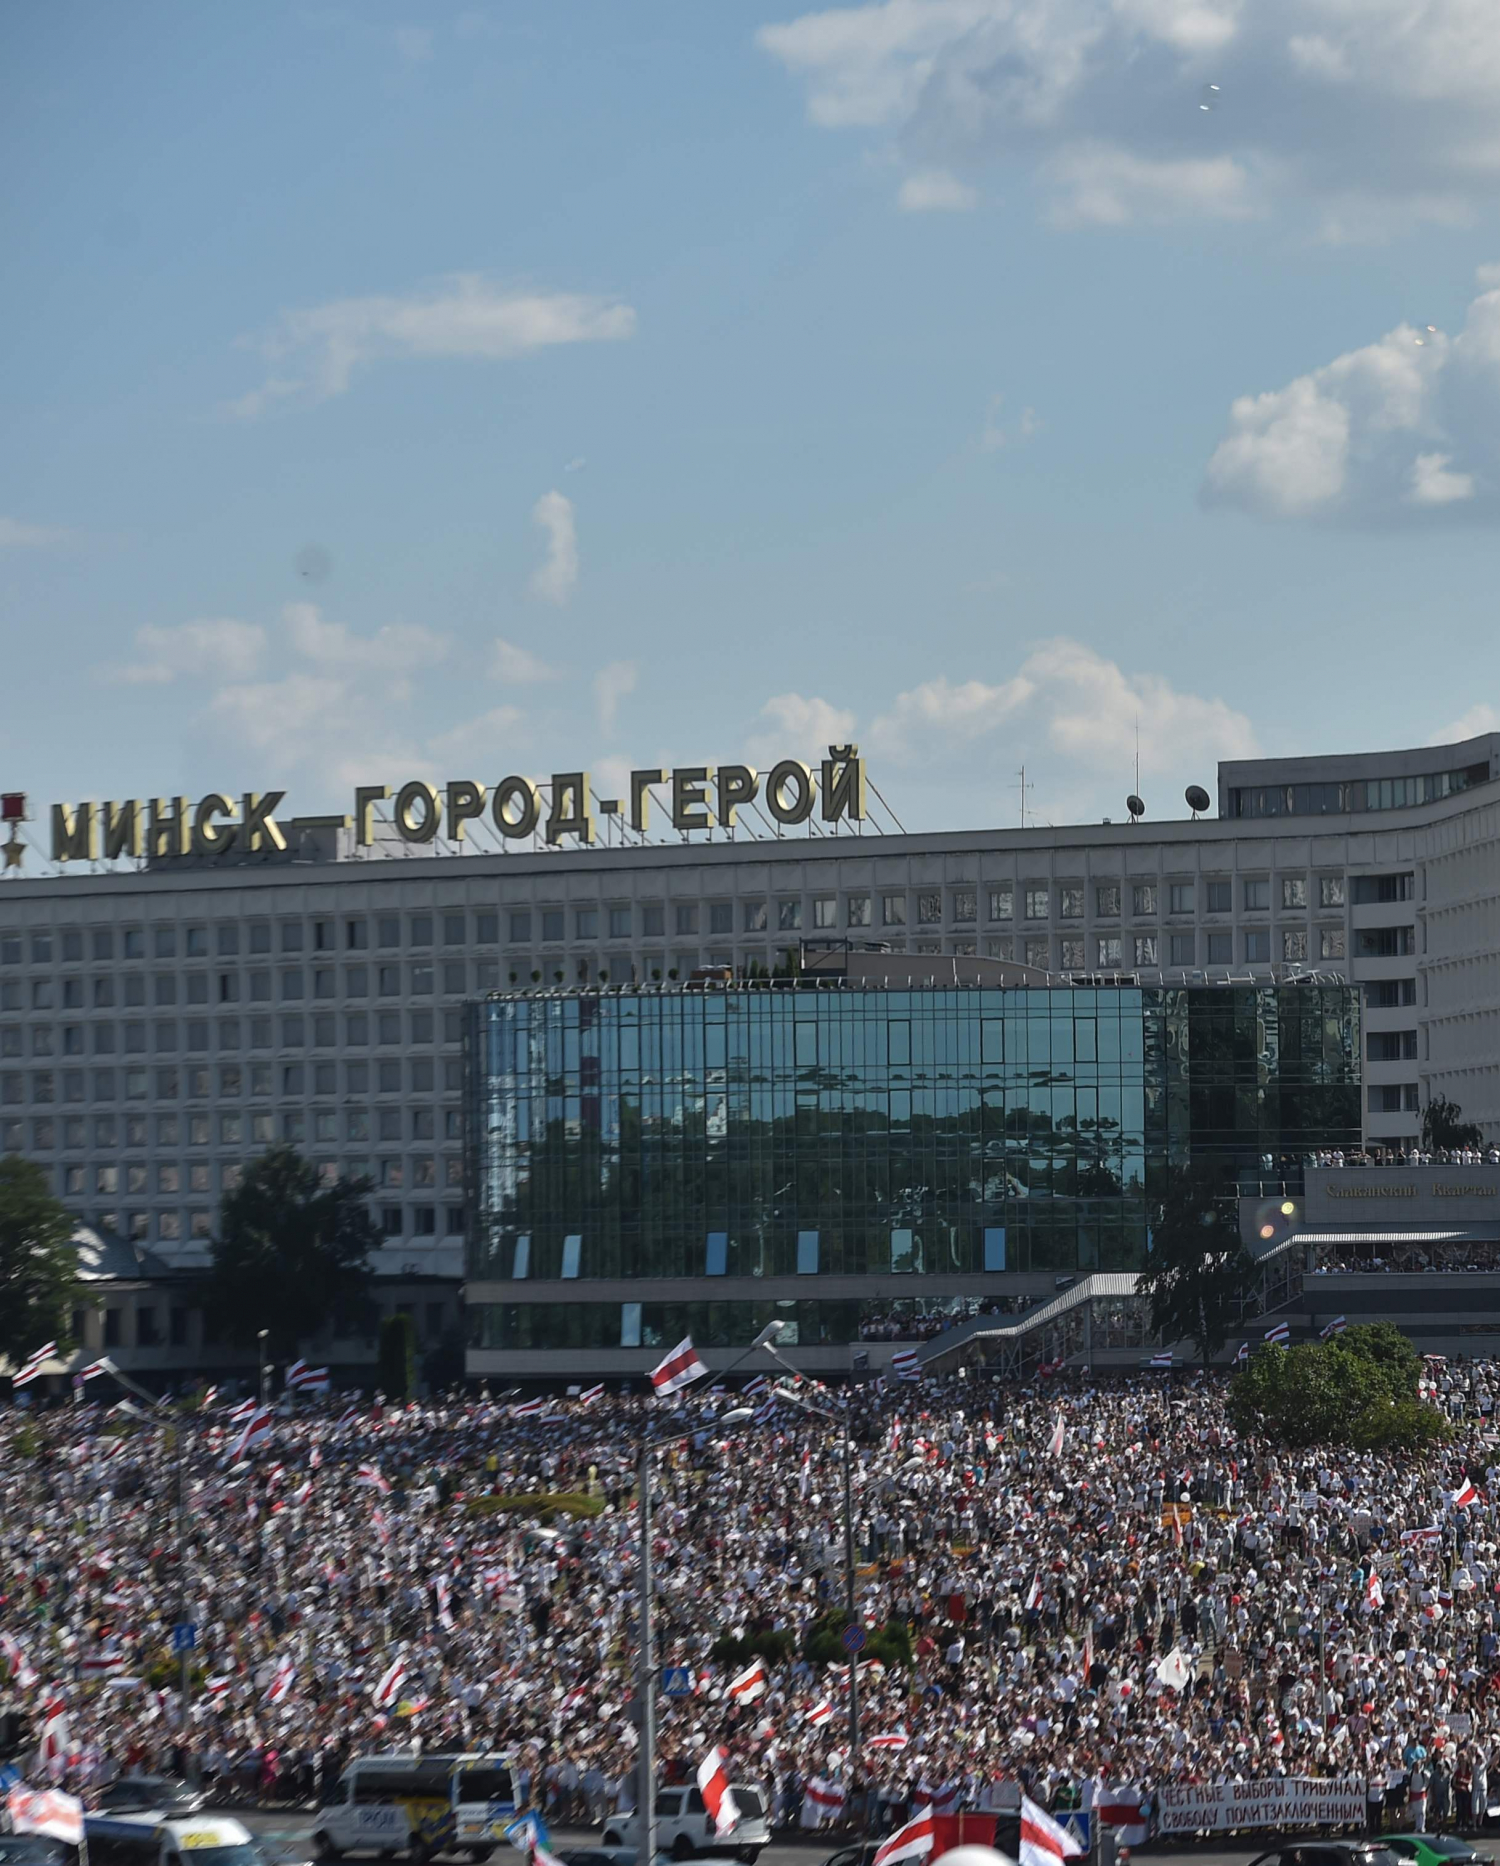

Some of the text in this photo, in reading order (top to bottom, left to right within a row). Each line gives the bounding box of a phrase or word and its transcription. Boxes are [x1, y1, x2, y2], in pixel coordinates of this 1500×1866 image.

[51, 790, 289, 862] МИНСК
[355, 744, 866, 847] ГОРОД-ГЕРОЙ
[1432, 1183, 1497, 1197] Квартал
[1161, 1785, 1225, 1807] ЧЕСТНЫЕ
[1162, 1802, 1365, 1830] СВОБОДУ ПОЛИТЗАКЛЮЧЕННЫМ
